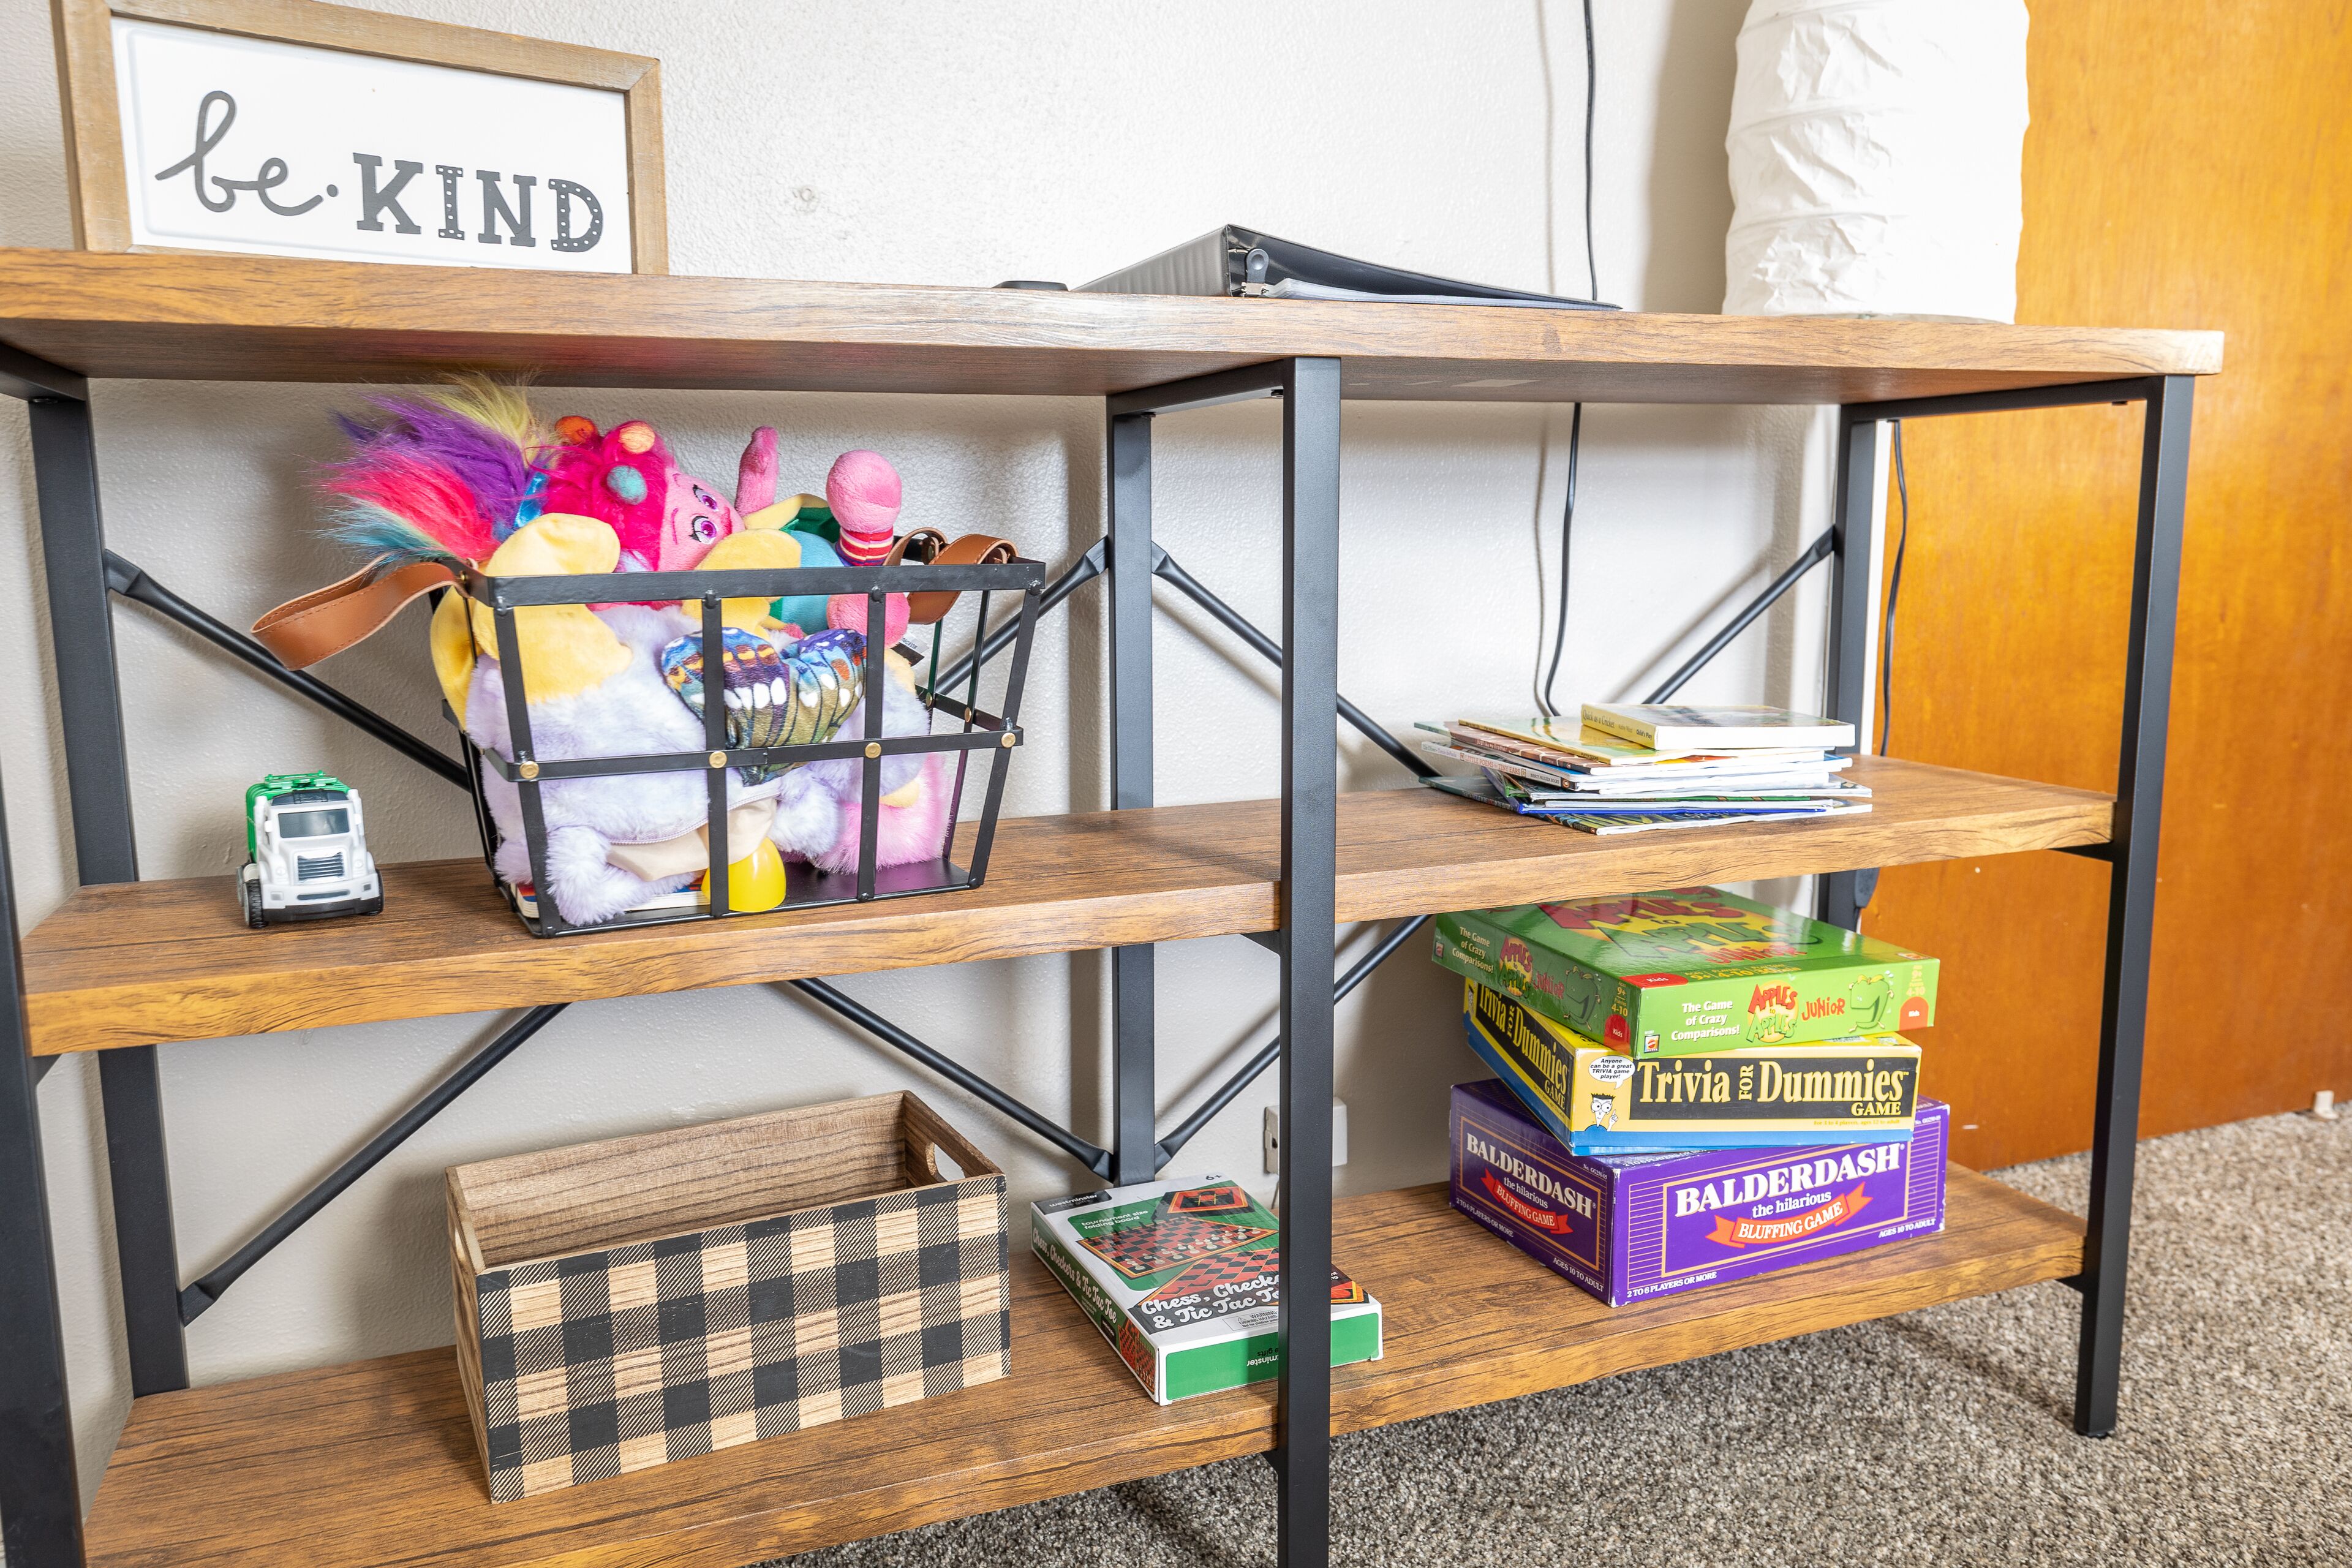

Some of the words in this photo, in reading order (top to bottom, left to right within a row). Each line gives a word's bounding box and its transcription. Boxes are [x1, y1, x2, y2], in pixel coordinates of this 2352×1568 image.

[352, 152, 604, 252] KIND
[1582, 709, 1594, 722] Quick
[1601, 715, 1615, 729] Cricket
[1636, 728, 1645, 737] Child's
[1464, 754, 1479, 764] LITTLE
[1479, 758, 1494, 768] POEMS
[1499, 763, 1509, 772] TINY
[1509, 766, 1520, 775] EARS
[1536, 898, 1747, 929] APPLES
[1460, 926, 1471, 939] The
[1472, 932, 1490, 947] Game
[1597, 922, 1823, 958] APPLES
[1452, 948, 1494, 973] Comparisons!
[1461, 940, 1468, 949] of
[1468, 944, 1487, 960] Crazy
[1499, 935, 1533, 973] APPLES
[1617, 987, 1626, 995] 9+
[1748, 984, 1798, 1014] APPLES
[1611, 1003, 1627, 1016] 4-10
[1682, 1003, 1702, 1014] The
[1703, 1000, 1733, 1012] Game
[1613, 1028, 1623, 1038] Kids
[1671, 1025, 1740, 1042] Comparisons!
[1686, 1016, 1697, 1027] of
[1699, 1014, 1728, 1026] Crazy
[1746, 1012, 1798, 1043] APPLES
[1479, 982, 1507, 1032] Trivia
[1513, 1006, 1568, 1095] Dummies
[1637, 1060, 1731, 1102] Trivia
[1738, 1064, 1754, 1101] FOR
[1544, 1080, 1566, 1110] GAME
[1851, 1101, 1901, 1116] GAME
[1049, 1194, 1098, 1207] westminster
[1496, 1185, 1532, 1219] BLUFFING
[1532, 1210, 1556, 1227] GAME
[1504, 1177, 1515, 1189] the
[1516, 1183, 1548, 1209] hilarious
[1752, 1204, 1774, 1218] the
[1775, 1191, 1831, 1213] hilarious
[1081, 1213, 1131, 1226] tournament
[1084, 1220, 1115, 1230] folding
[1115, 1215, 1140, 1224] board
[1460, 1199, 1466, 1209] TO
[1470, 1206, 1491, 1224] PLAYERS
[1491, 1218, 1499, 1228] OR
[1498, 1223, 1514, 1238] MORE
[1738, 1219, 1803, 1240] BLUFFING
[1804, 1202, 1843, 1231] GAME
[1879, 1227, 1897, 1238] AGES
[1914, 1218, 1936, 1229] ADULT
[1033, 1227, 1049, 1256] Chess,
[1050, 1244, 1075, 1281] Checkers
[1076, 1271, 1082, 1289] &
[1082, 1275, 1092, 1298] Tic
[1092, 1286, 1104, 1311] Tac
[1105, 1298, 1117, 1324] Toe
[1553, 1257, 1569, 1272] AGES
[1569, 1265, 1576, 1275] 10
[1576, 1270, 1584, 1281] TO
[1585, 1274, 1604, 1292] ADULT
[1632, 1288, 1644, 1297] TO
[1650, 1279, 1684, 1293] PLAYERS
[1684, 1276, 1695, 1285] OR
[1695, 1272, 1717, 1283] MORE
[1141, 1293, 1211, 1314] Chess,
[1153, 1315, 1175, 1329] &
[1174, 1306, 1212, 1323] Tic
[1212, 1297, 1256, 1313] Tac
[1256, 1287, 1279, 1302] To
[1257, 1348, 1273, 1356] gifts
